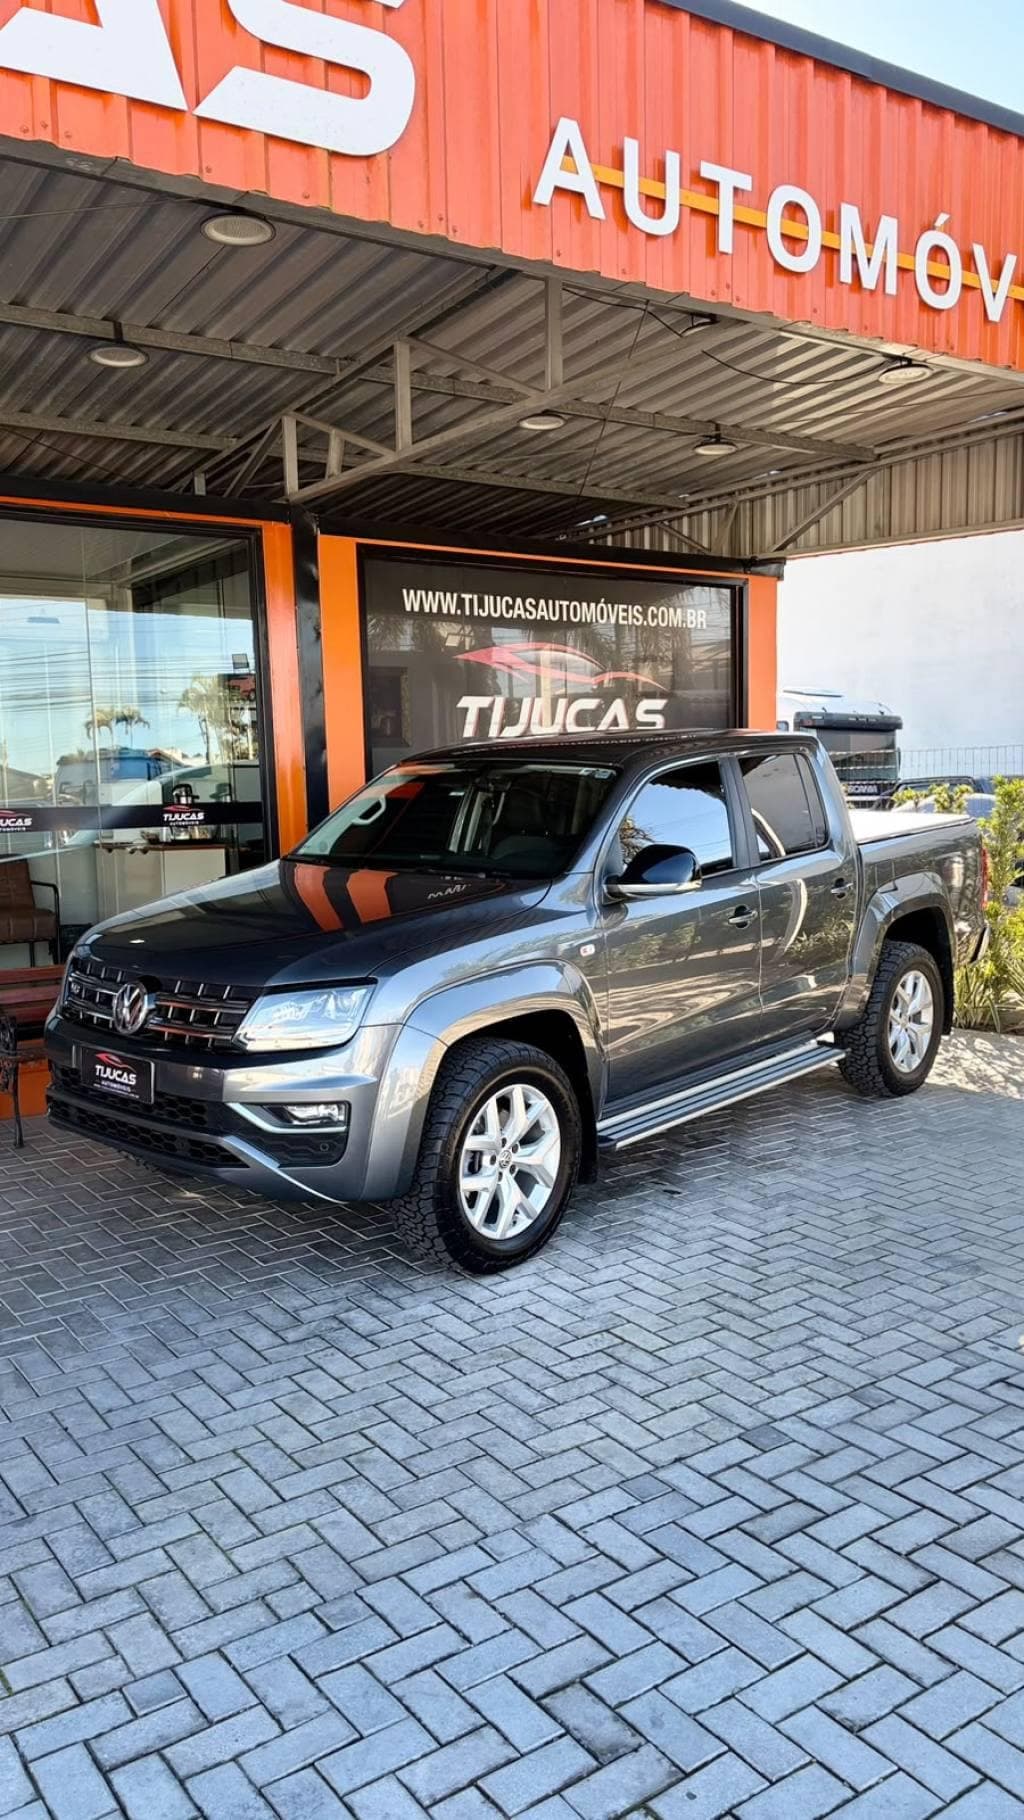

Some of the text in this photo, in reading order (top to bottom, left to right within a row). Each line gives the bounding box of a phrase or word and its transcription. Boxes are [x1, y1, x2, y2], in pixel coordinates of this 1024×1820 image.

[533, 117, 1017, 323] AUTOMÓV
[402, 588, 707, 629] WWW.TIJUCASAUTOMÓVEIS.COM.BR
[456, 695, 668, 738] TIJUCAS
[163, 812, 205, 821] TIJUCAS
[95, 1064, 137, 1085] TIJUCAS
